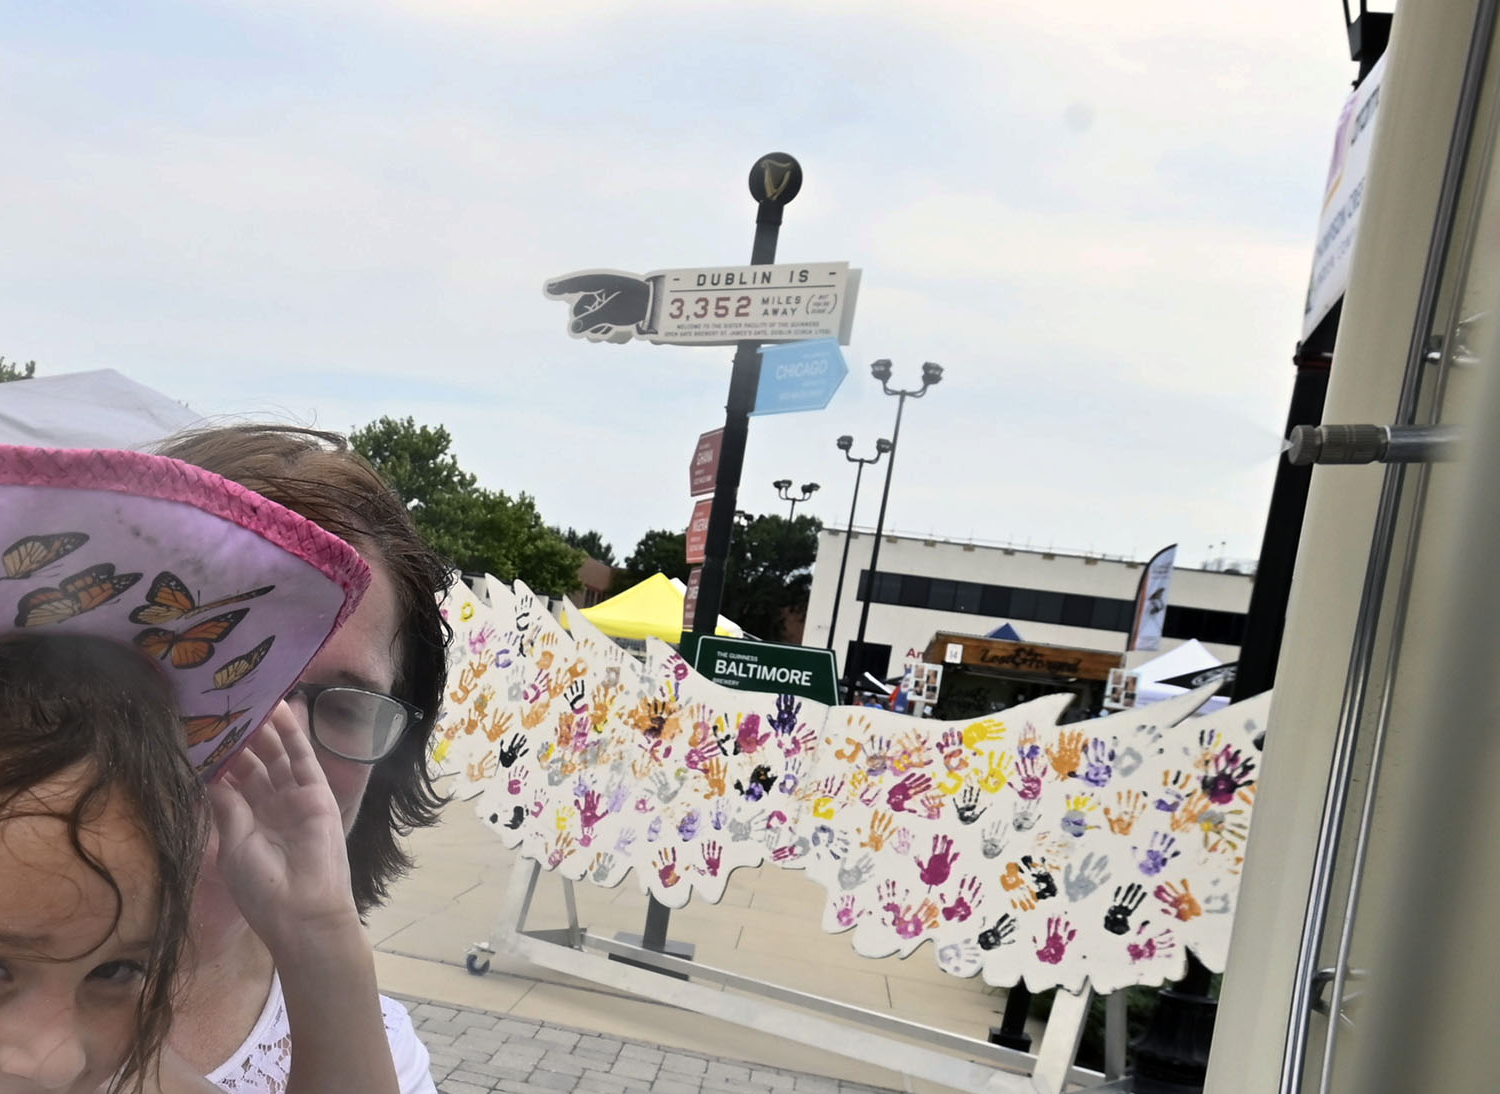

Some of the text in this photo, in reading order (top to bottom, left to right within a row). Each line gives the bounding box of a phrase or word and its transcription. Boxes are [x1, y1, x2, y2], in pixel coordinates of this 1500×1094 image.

[696, 269, 810, 287] DUBLIN IS
[669, 295, 752, 321] 3,352
[760, 295, 801, 306] MILES
[762, 307, 798, 317] AWAY
[775, 359, 829, 380] CHICAGO
[716, 651, 758, 663] THE GUINNESS
[714, 659, 813, 687] BALTIMORE
[712, 678, 740, 687] BREWERY
